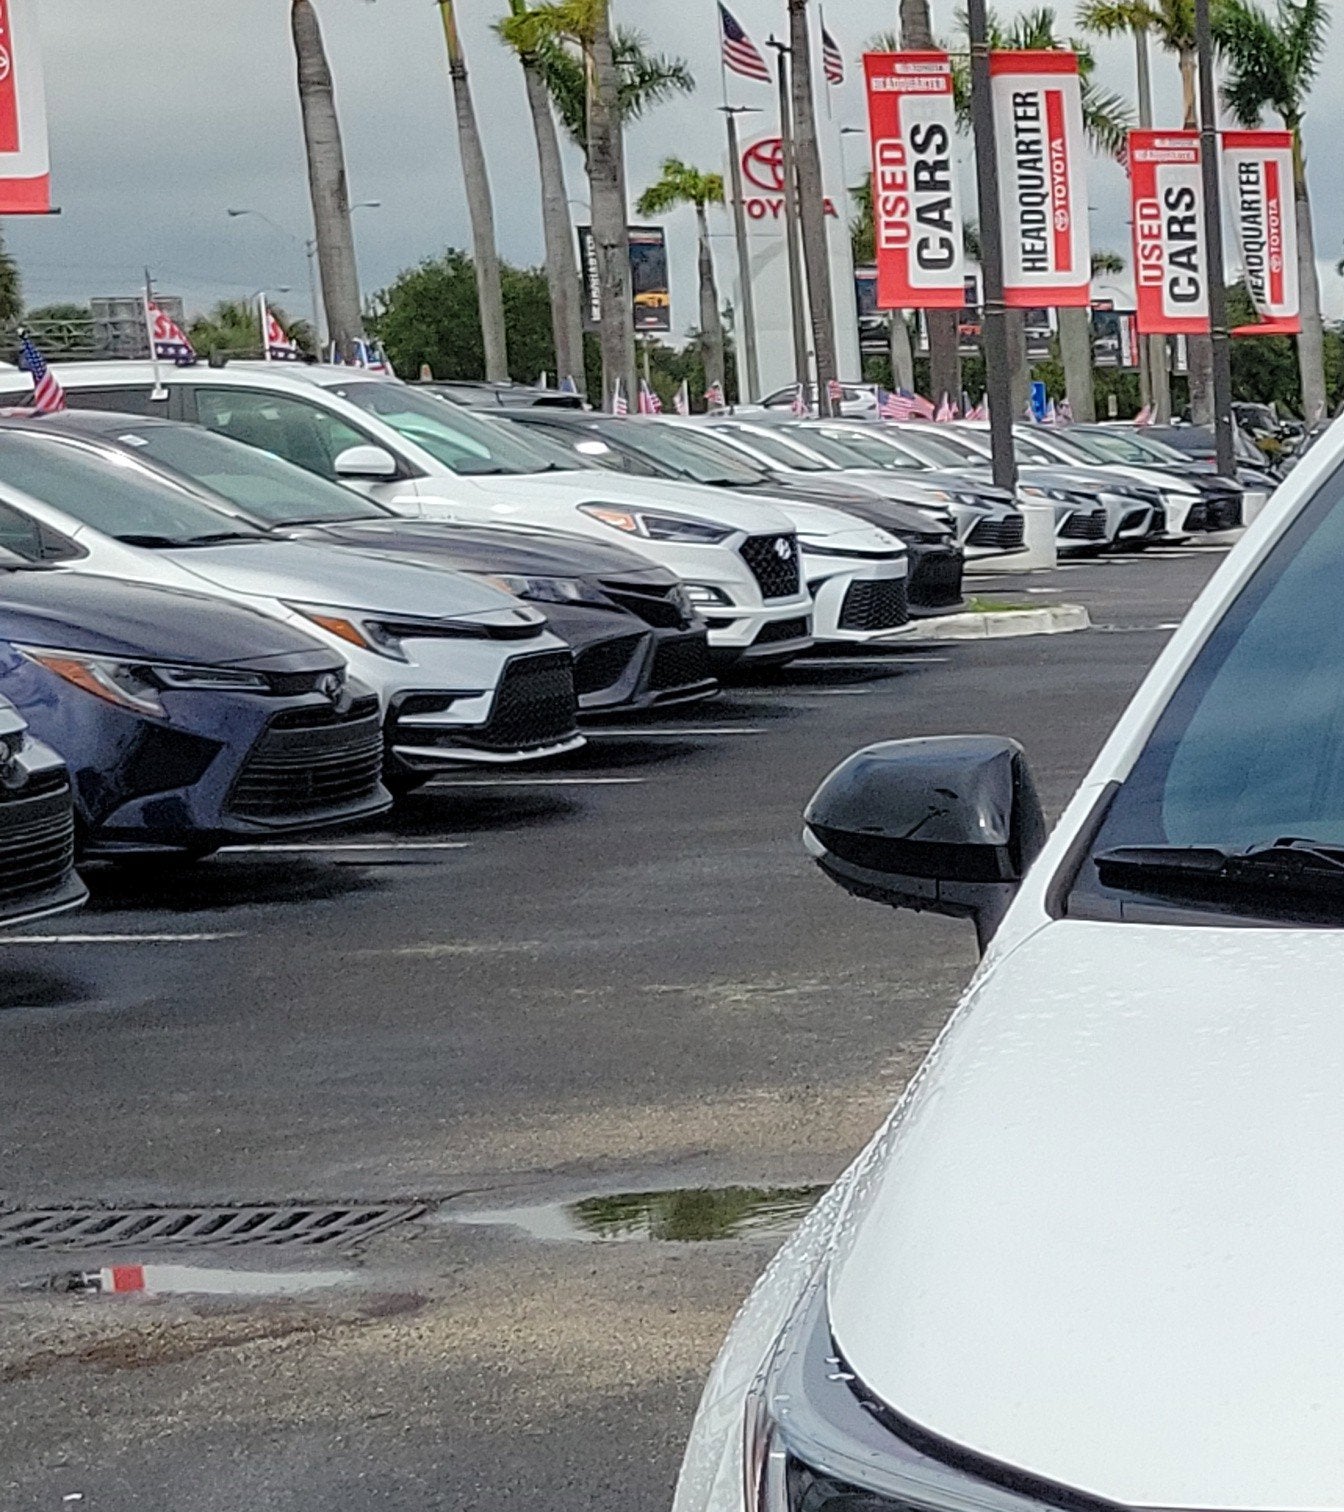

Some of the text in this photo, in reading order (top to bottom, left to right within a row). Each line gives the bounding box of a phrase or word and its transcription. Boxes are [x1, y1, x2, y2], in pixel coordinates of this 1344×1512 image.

[735, 198, 839, 219] OYA
[876, 138, 911, 249] USED
[910, 123, 955, 270] CARS
[1012, 91, 1049, 273] HEADQUARTER
[1051, 138, 1067, 207] TOYOTA
[1268, 199, 1281, 255] TOYOTA
[1137, 199, 1164, 286] USED
[1165, 187, 1201, 303] CARS
[1239, 161, 1266, 305] HEADQUARTER
